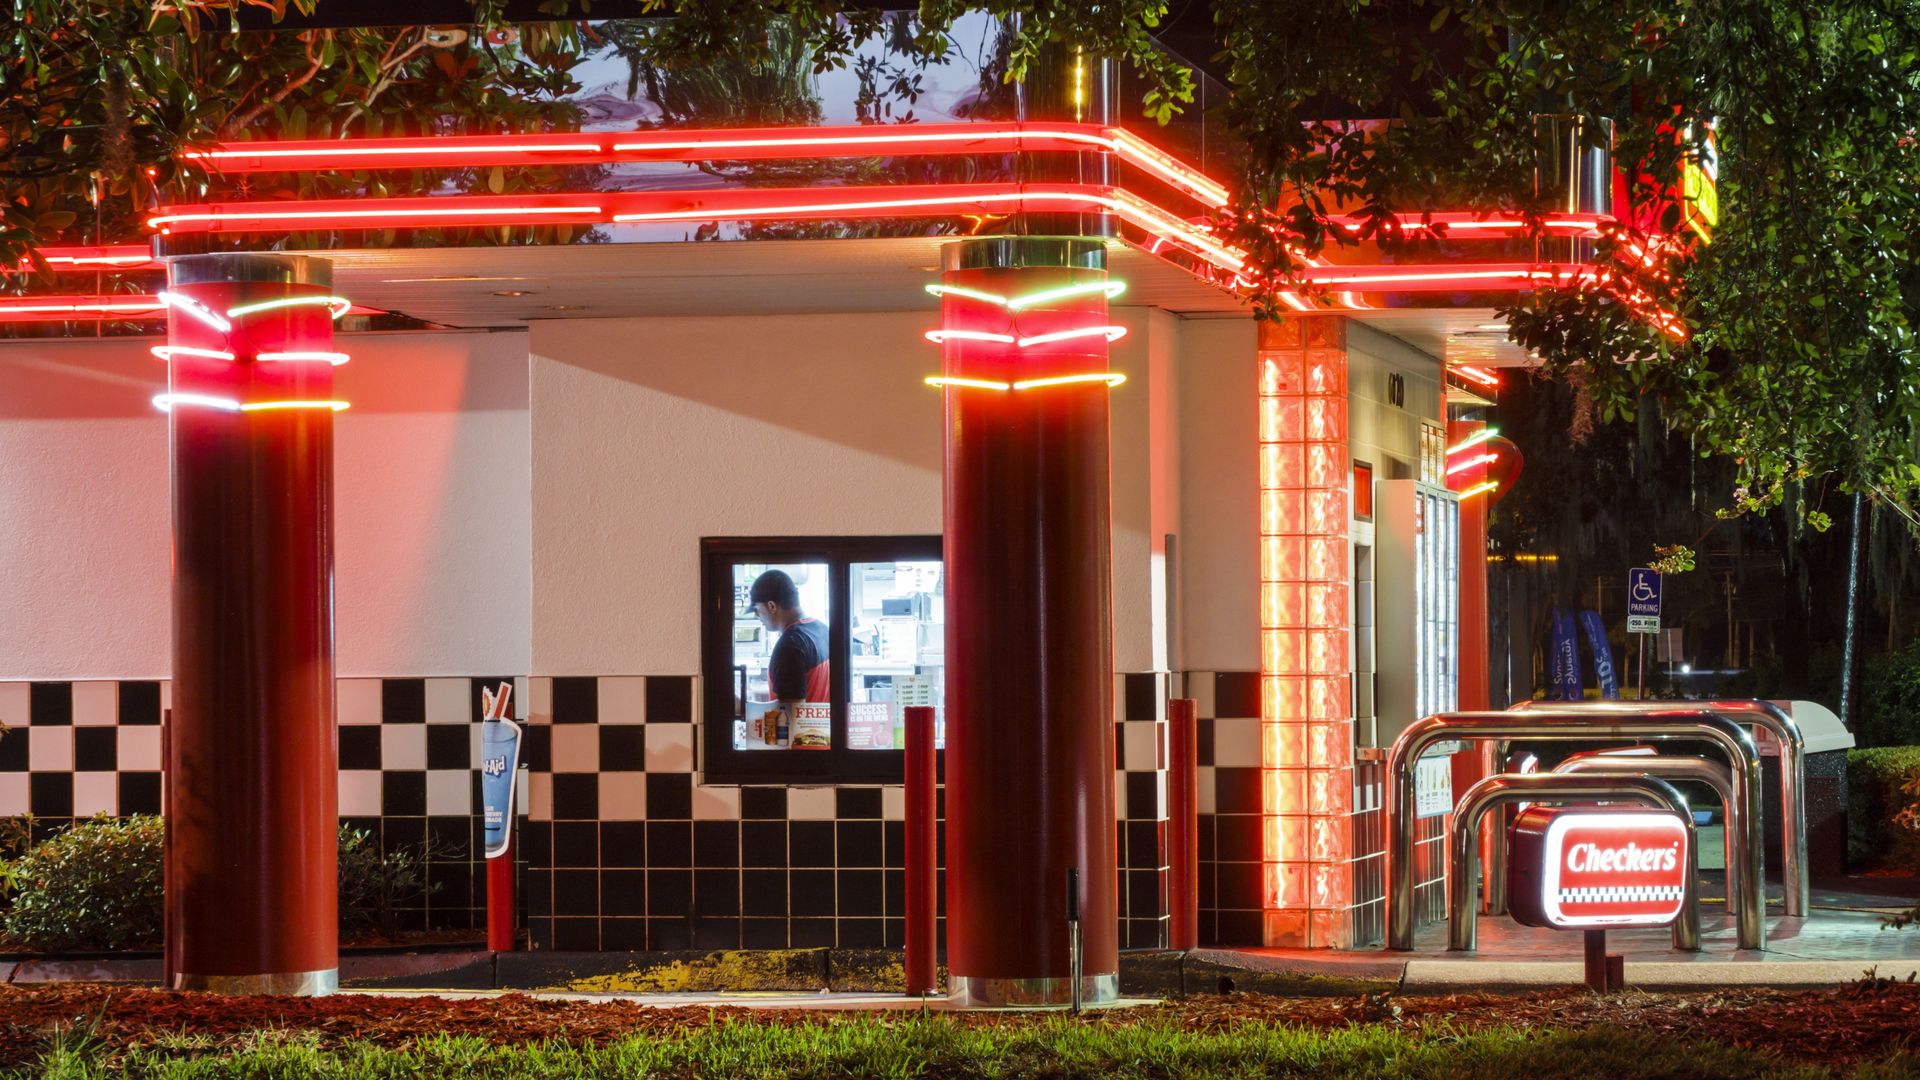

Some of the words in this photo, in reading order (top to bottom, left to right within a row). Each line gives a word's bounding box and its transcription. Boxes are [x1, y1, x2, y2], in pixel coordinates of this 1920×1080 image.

[1631, 603, 1658, 613] PARKING
[850, 703, 888, 716] SUCCESS
[1567, 842, 1677, 872] Checkers
